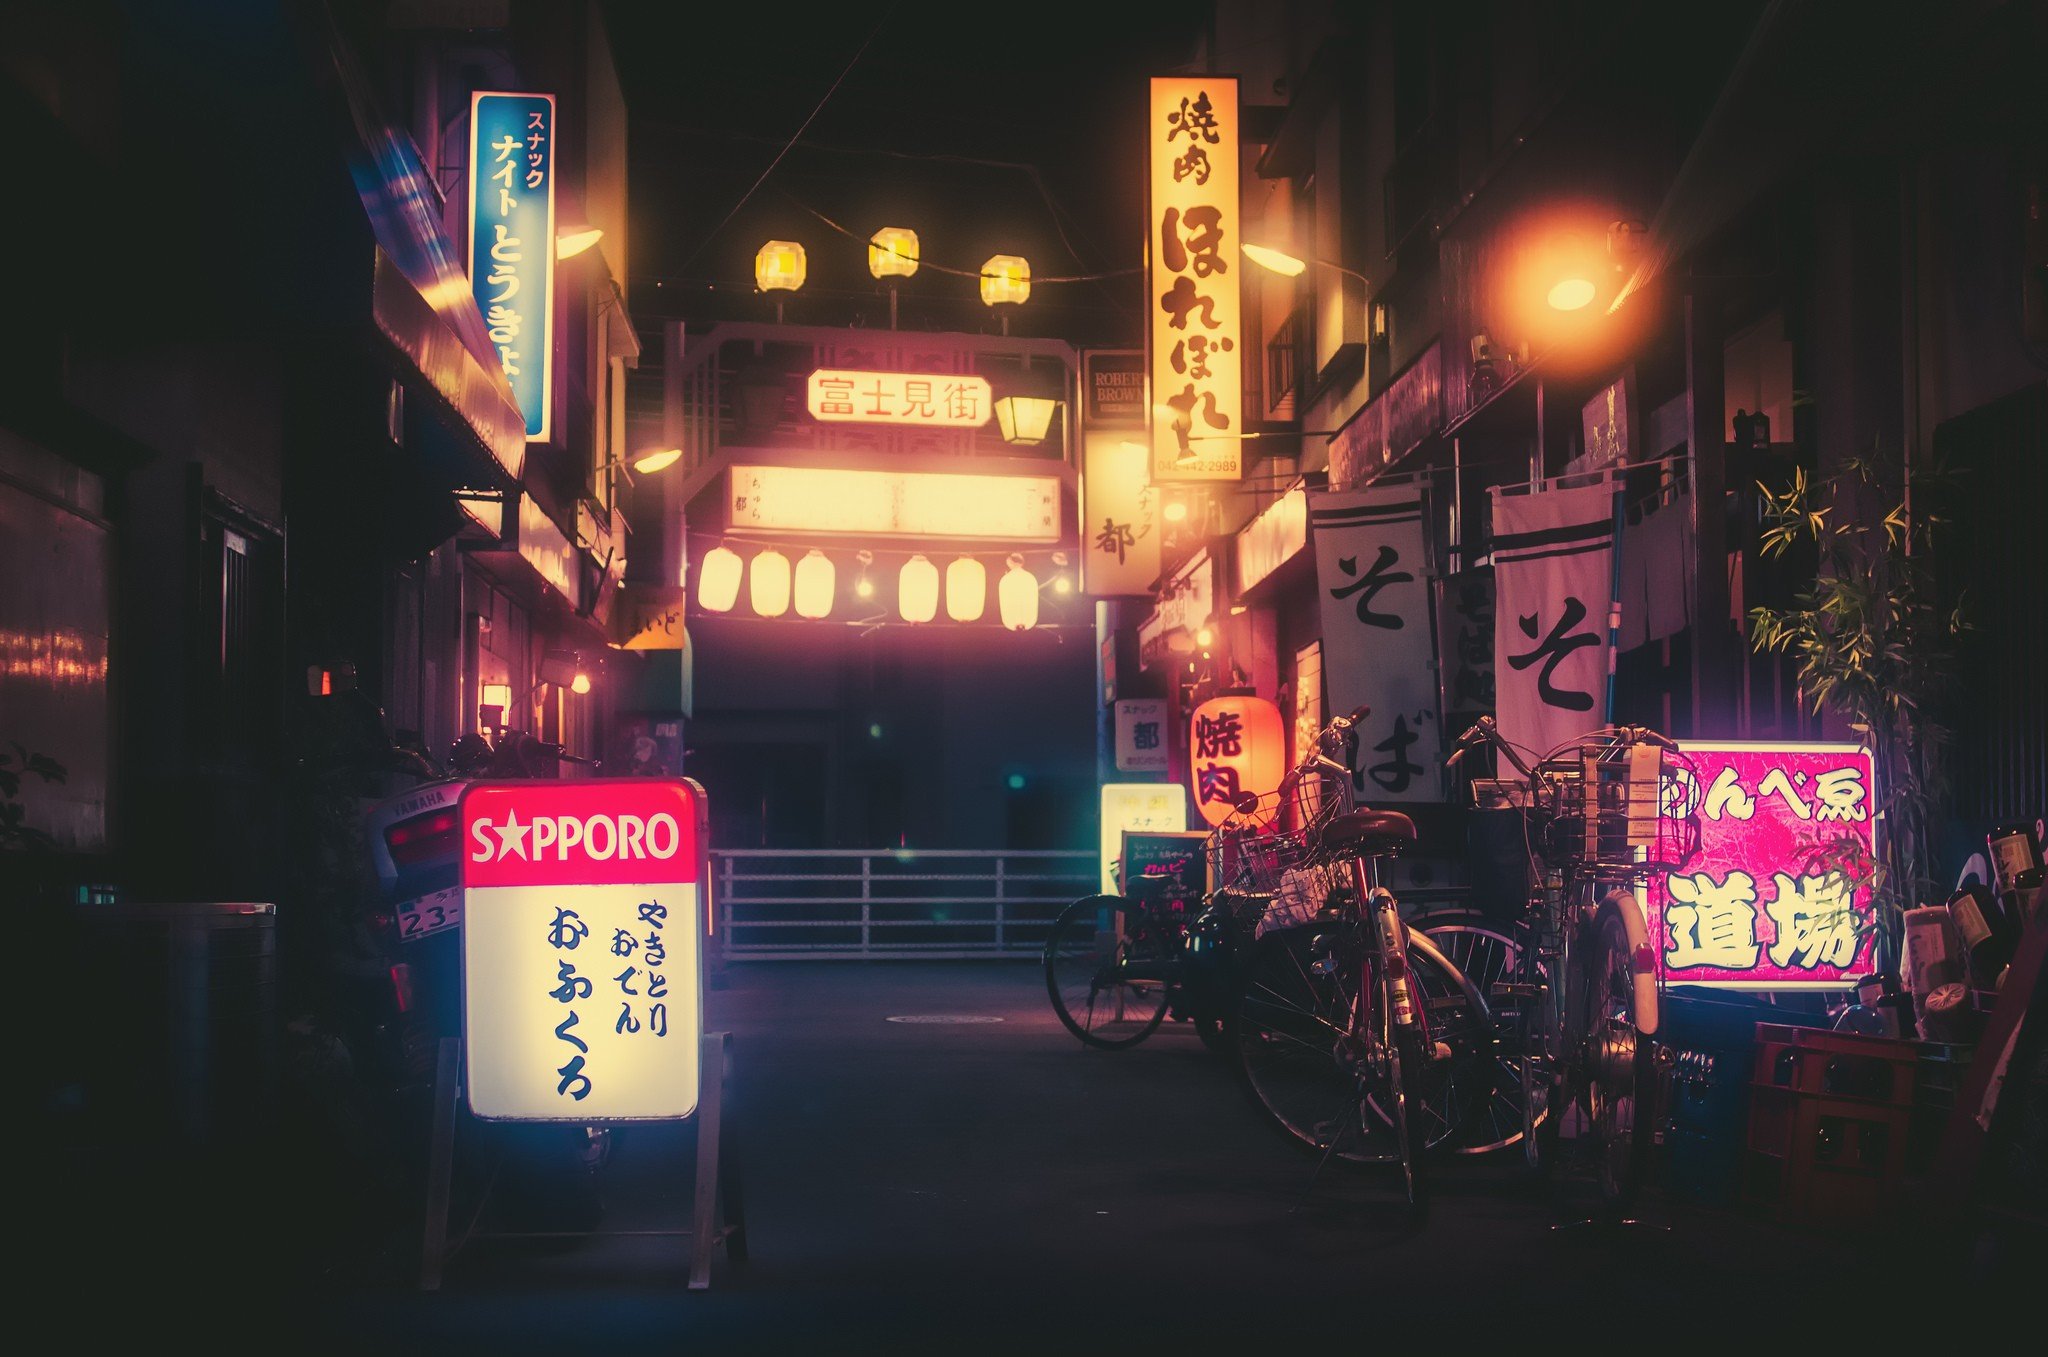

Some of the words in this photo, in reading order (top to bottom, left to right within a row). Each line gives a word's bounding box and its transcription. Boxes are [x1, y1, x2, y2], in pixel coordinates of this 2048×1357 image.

[525, 112, 545, 189] スナック
[819, 376, 978, 420] 富士見街
[1094, 518, 1135, 566] 都
[1330, 545, 1434, 793] そば
[1133, 722, 1160, 749] 都
[1196, 711, 1245, 806] 焼肉
[395, 791, 445, 817] YAMAHA
[1665, 870, 1866, 970] 道場
[547, 906, 593, 1102] おふくろ
[611, 927, 641, 1035] おでん
[637, 899, 668, 1038] やきとり
